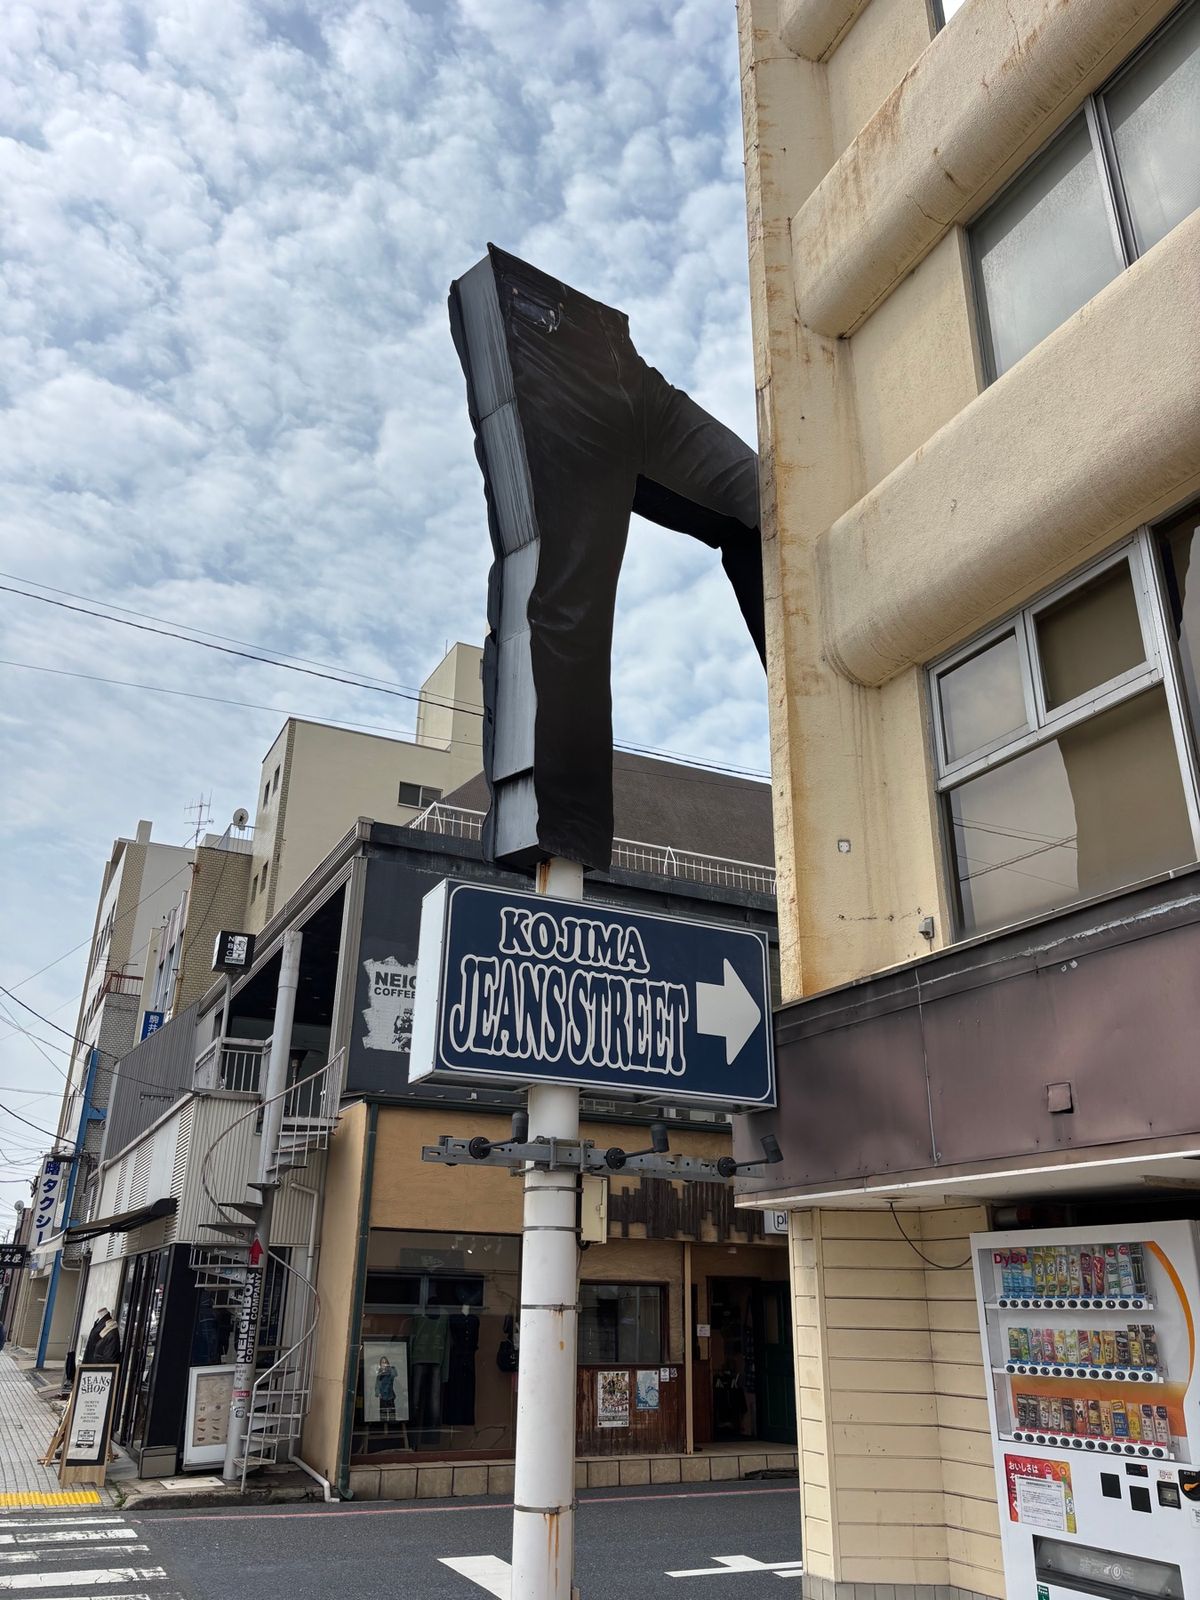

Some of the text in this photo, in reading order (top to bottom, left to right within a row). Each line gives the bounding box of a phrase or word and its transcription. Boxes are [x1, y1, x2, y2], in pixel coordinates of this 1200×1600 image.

[499, 907, 650, 974] KOJIMA
[450, 954, 689, 1077] JEANS STREET
[993, 1252, 1028, 1267] DyDo
[251, 1272, 263, 1320] COMPANY
[246, 1324, 257, 1363] COFFEE
[81, 1385, 106, 1394] SHOP
[82, 1376, 111, 1386] JEANS
[1008, 1460, 1039, 1474] おいしさは
